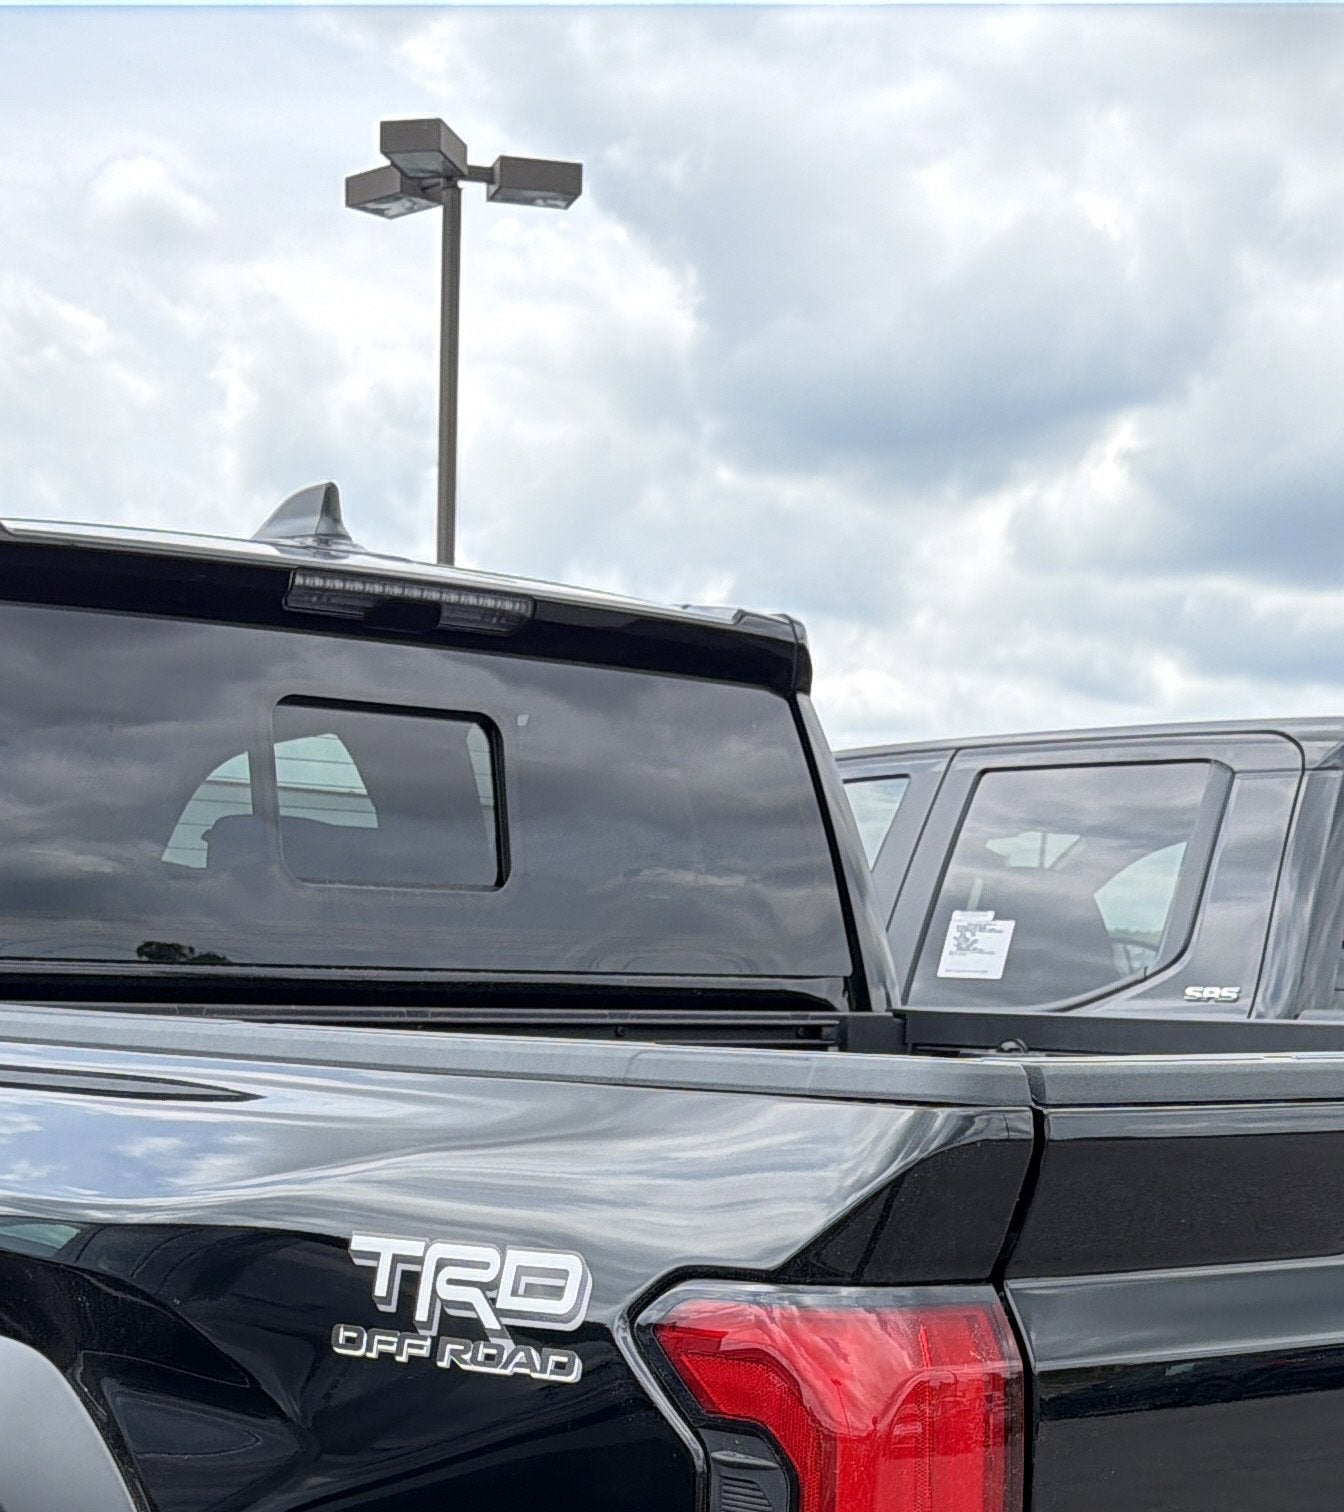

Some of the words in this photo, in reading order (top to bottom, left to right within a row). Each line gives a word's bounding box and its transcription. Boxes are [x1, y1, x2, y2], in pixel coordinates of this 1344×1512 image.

[1184, 986, 1241, 1002] SR5
[348, 1231, 593, 1346] TRD
[331, 1324, 431, 1364] OFF
[436, 1337, 583, 1384] ROAD
